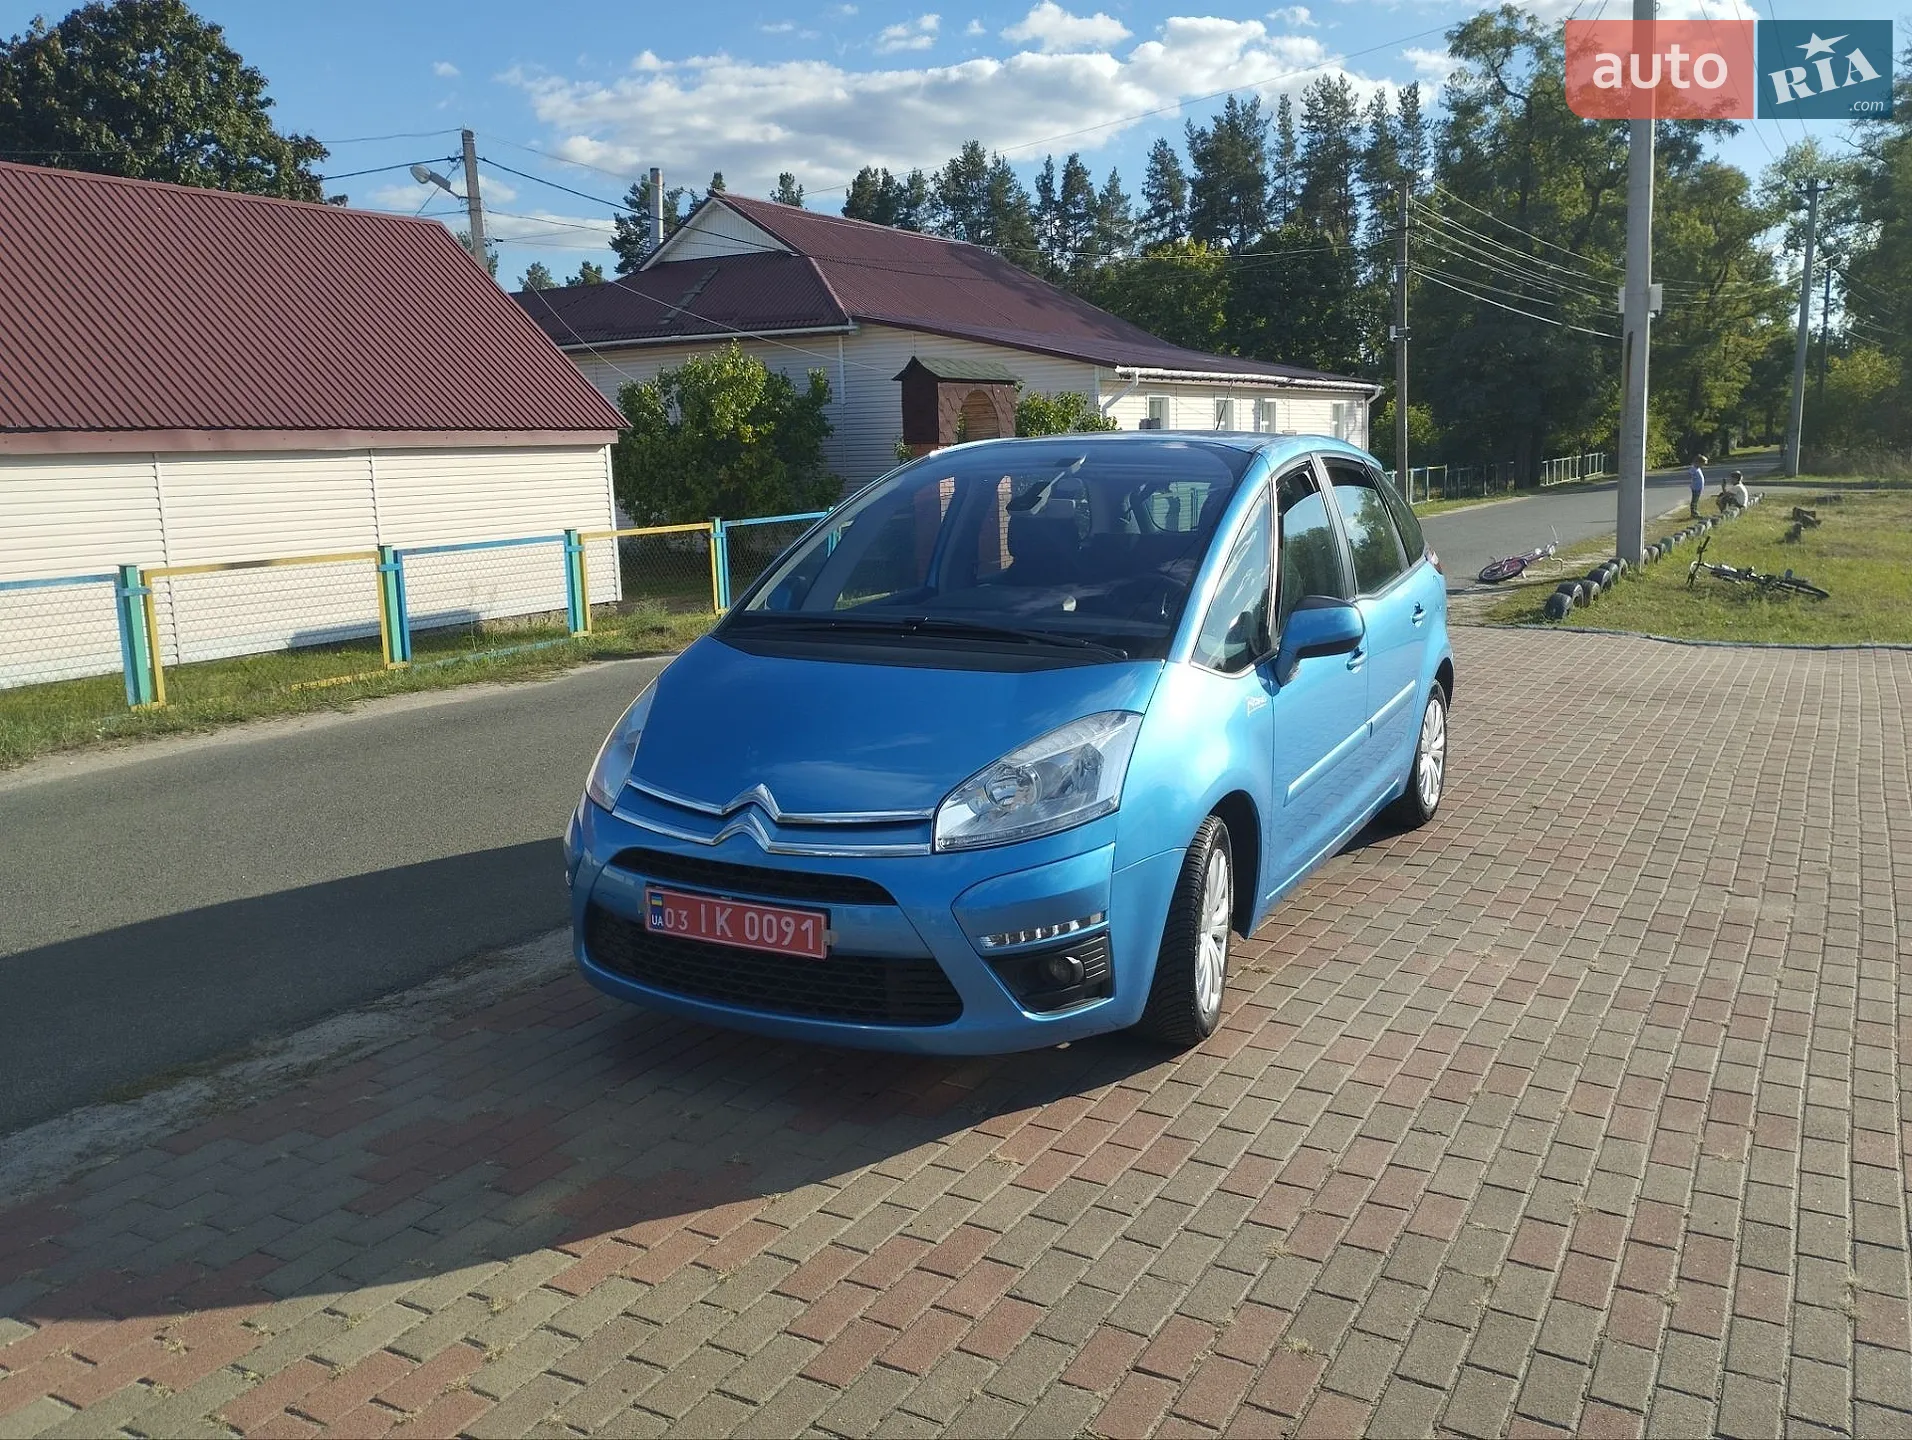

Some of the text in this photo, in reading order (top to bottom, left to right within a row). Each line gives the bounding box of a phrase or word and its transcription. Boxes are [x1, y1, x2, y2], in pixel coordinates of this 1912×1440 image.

[651, 914, 664, 927] UA
[664, 903, 814, 950] 03 IK 0091
